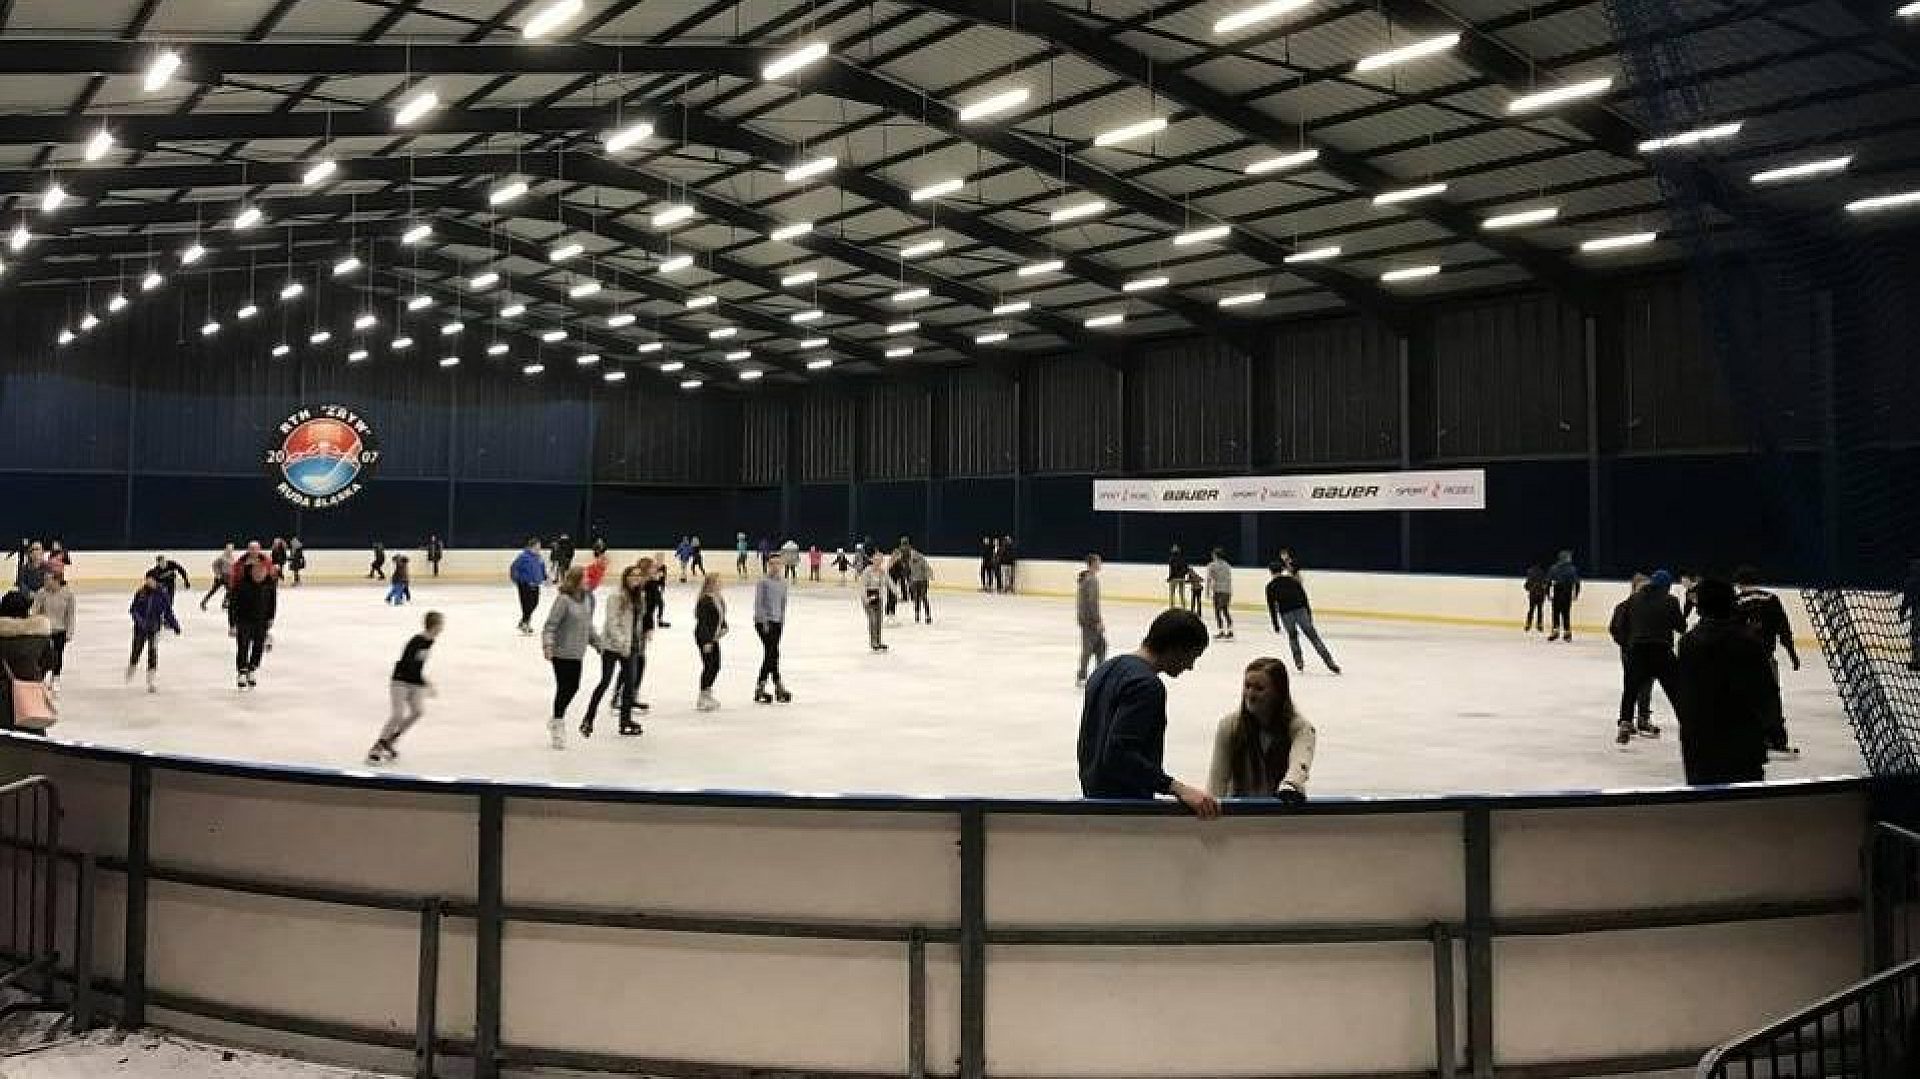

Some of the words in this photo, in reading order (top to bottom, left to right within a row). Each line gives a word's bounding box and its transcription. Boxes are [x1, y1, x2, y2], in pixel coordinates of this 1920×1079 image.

[266, 450, 285, 463] 20
[361, 451, 379, 463] 07
[1163, 489, 1220, 501] BAUER
[1311, 485, 1380, 499] BAUER
